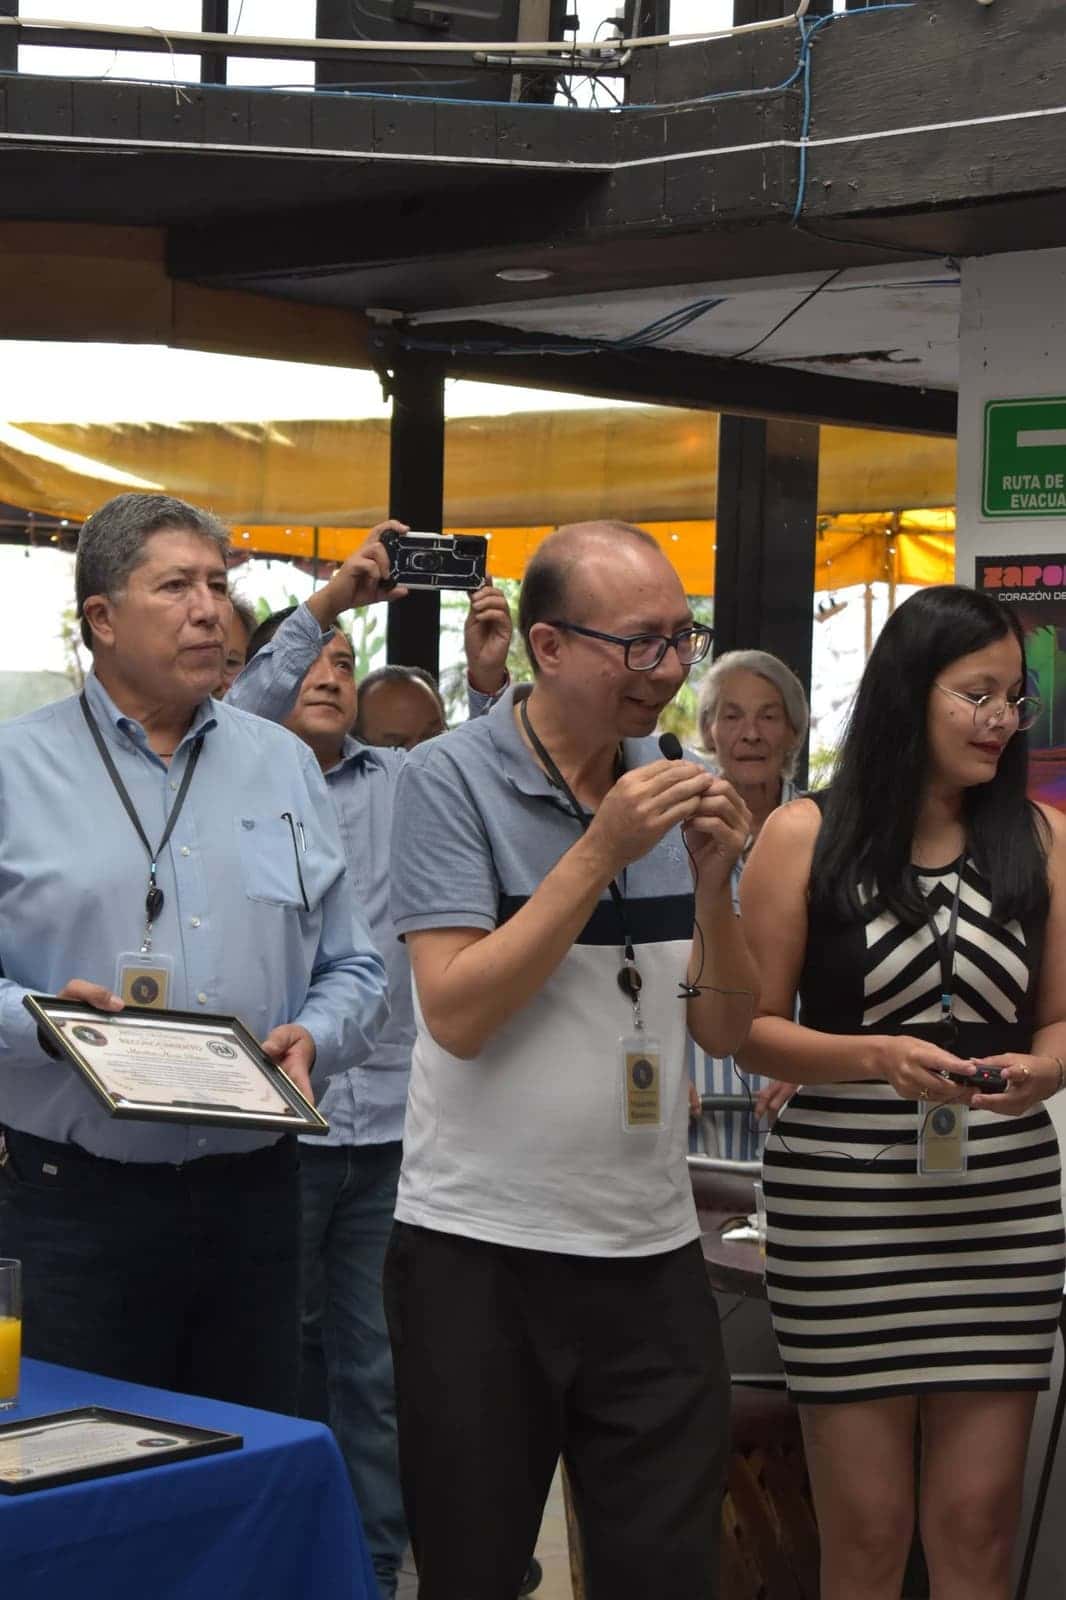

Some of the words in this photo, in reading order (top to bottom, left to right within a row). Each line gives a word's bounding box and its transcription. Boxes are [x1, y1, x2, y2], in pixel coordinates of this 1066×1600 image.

[1002, 475, 1041, 490] RUTA
[1045, 474, 1065, 489] DE
[1010, 493, 1066, 509] EVACUA
[998, 590, 1051, 601] CORAZÓN
